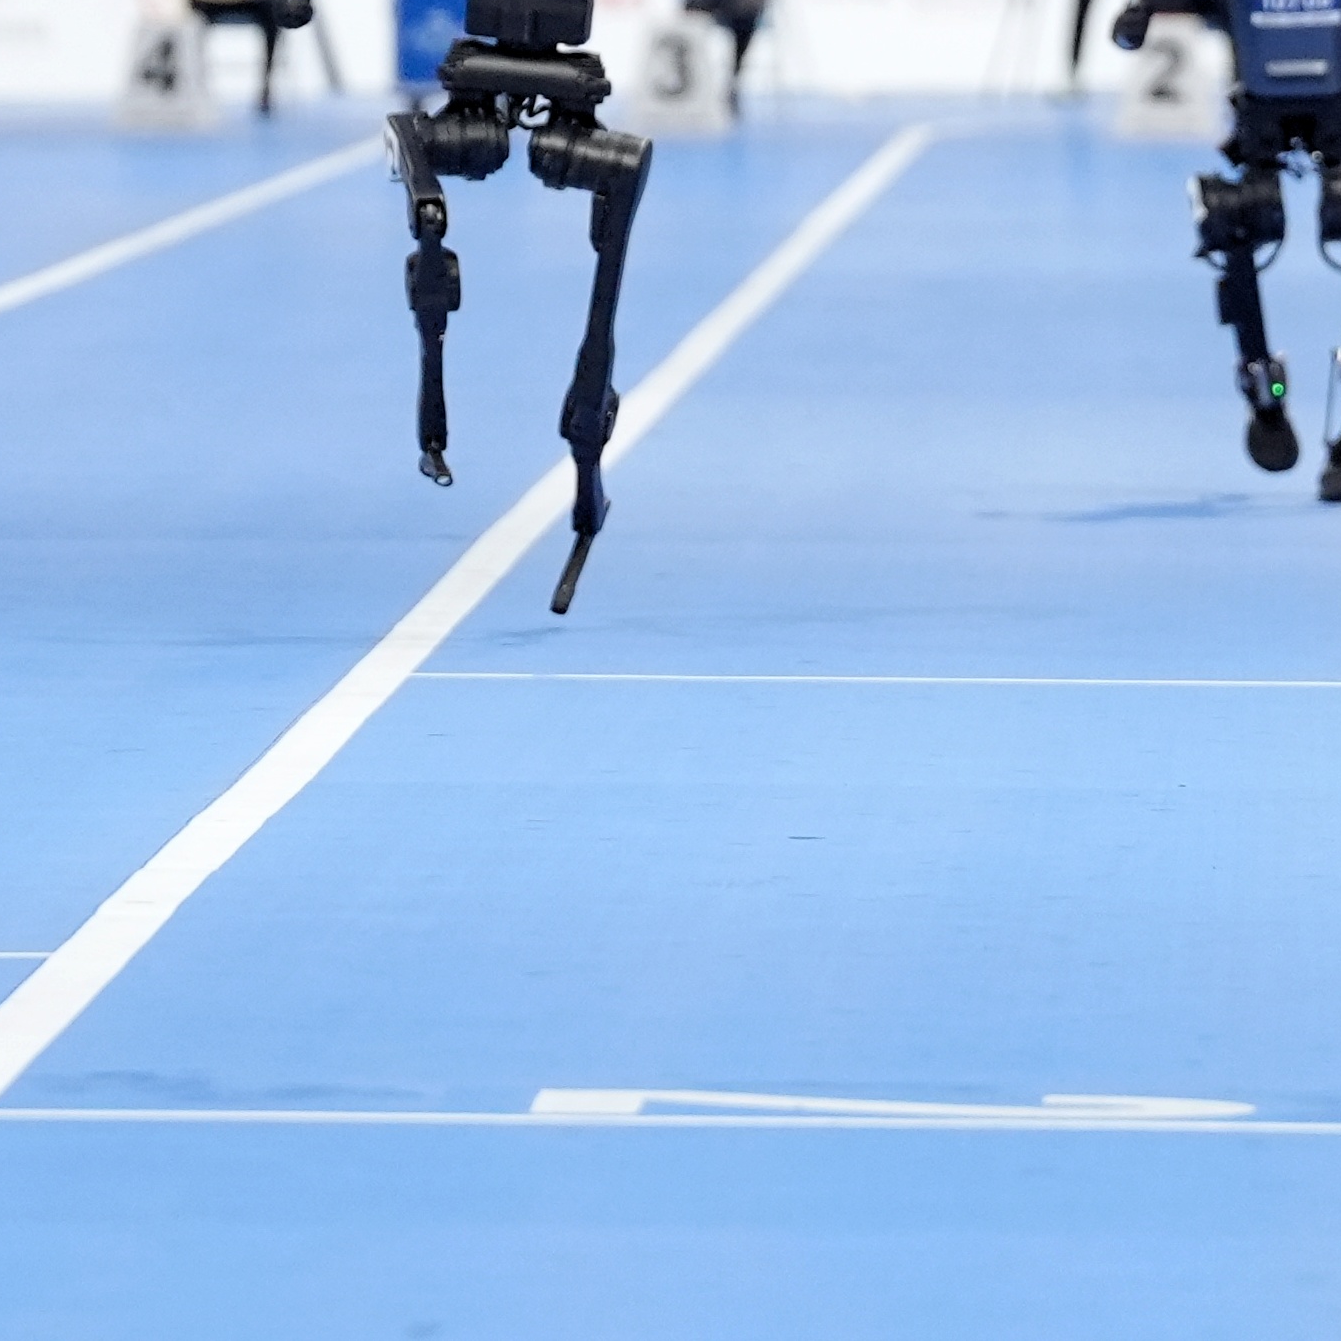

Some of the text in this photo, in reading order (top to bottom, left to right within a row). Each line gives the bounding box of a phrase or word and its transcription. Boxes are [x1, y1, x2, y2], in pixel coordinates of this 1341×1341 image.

[136, 35, 177, 93] 4
[653, 33, 692, 101] 3
[1148, 40, 1186, 102] 2
